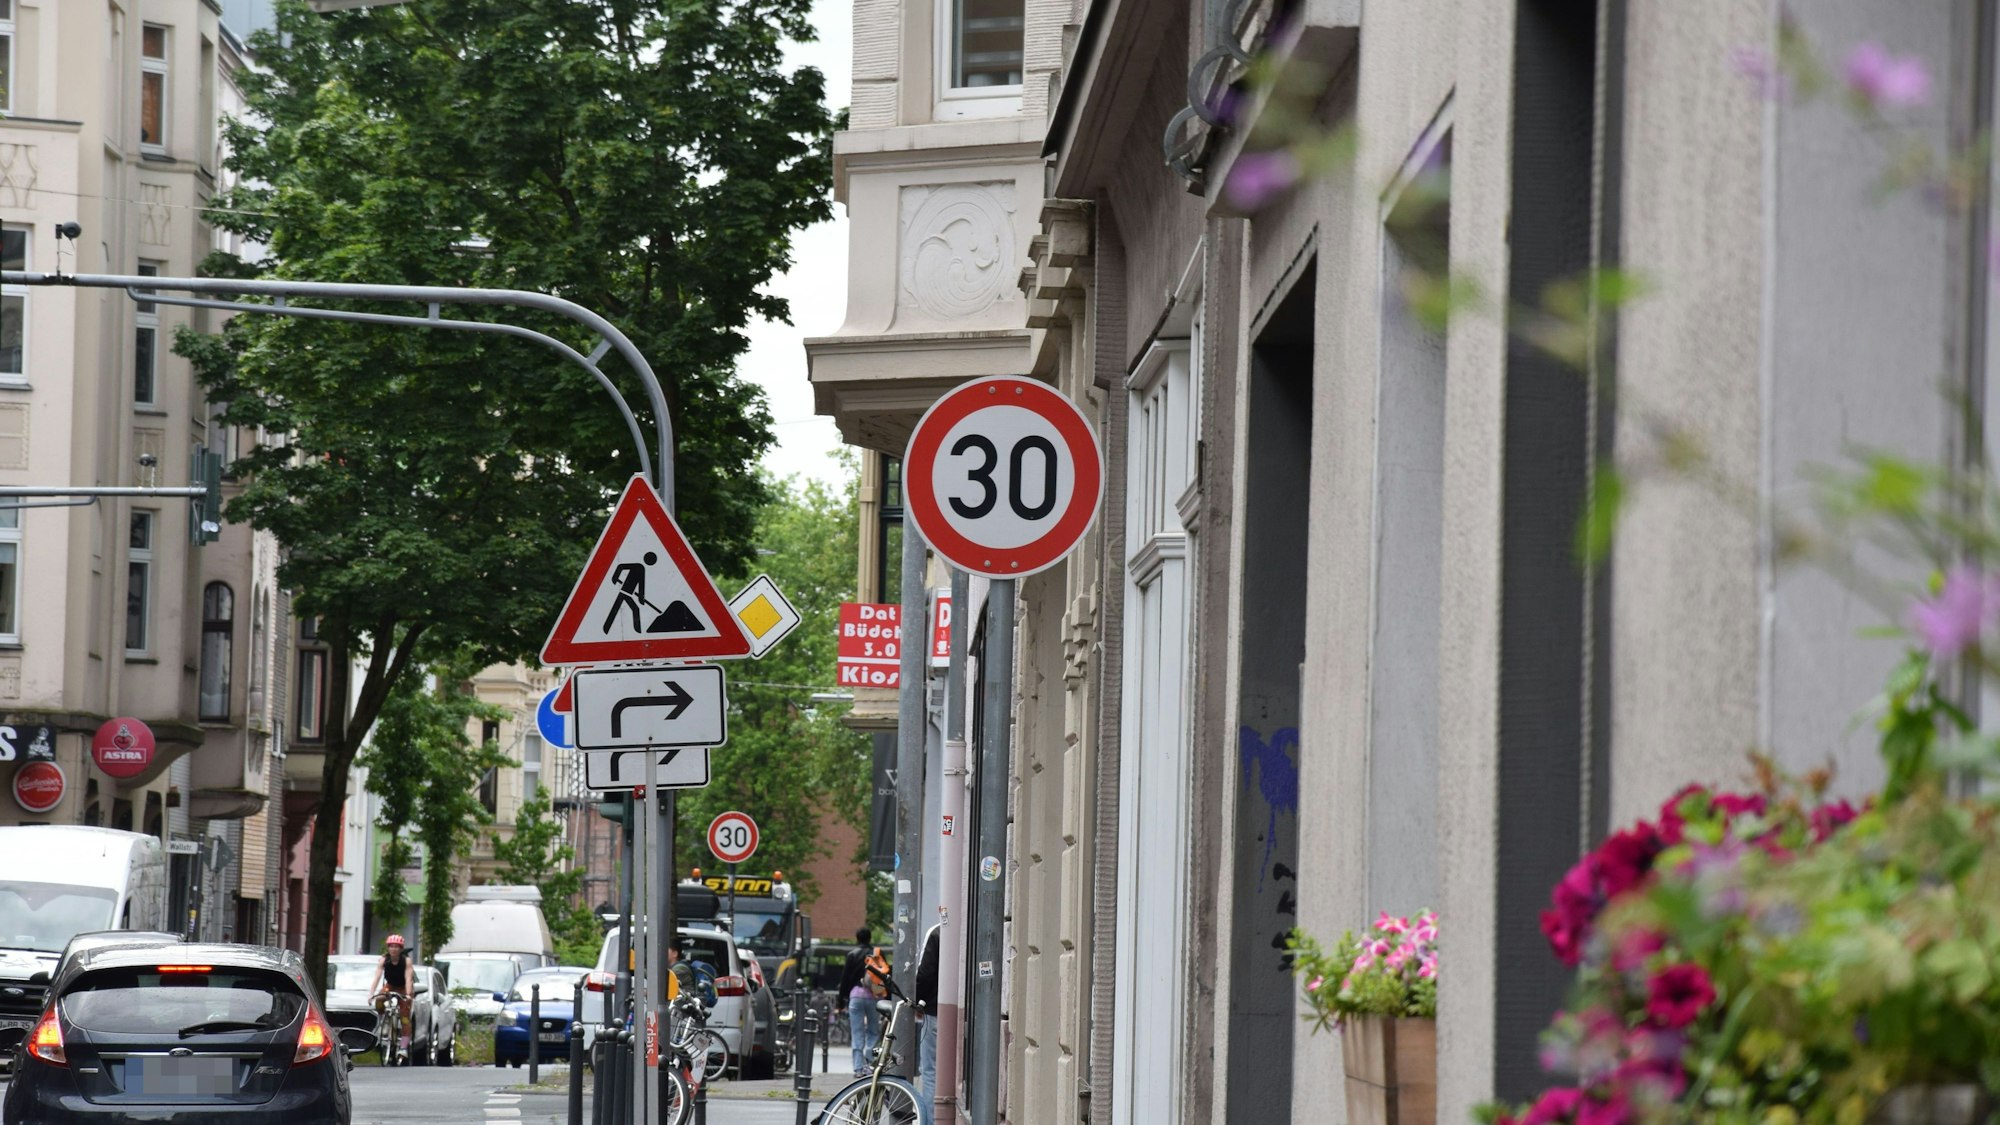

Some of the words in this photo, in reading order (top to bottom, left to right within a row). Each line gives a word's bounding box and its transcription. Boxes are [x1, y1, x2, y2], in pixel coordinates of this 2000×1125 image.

[948, 433, 1058, 521] 30
[860, 605, 896, 621] Dat
[864, 642, 896, 657] 3.0
[103, 751, 142, 760] ASTRA
[720, 826, 747, 848] 30
